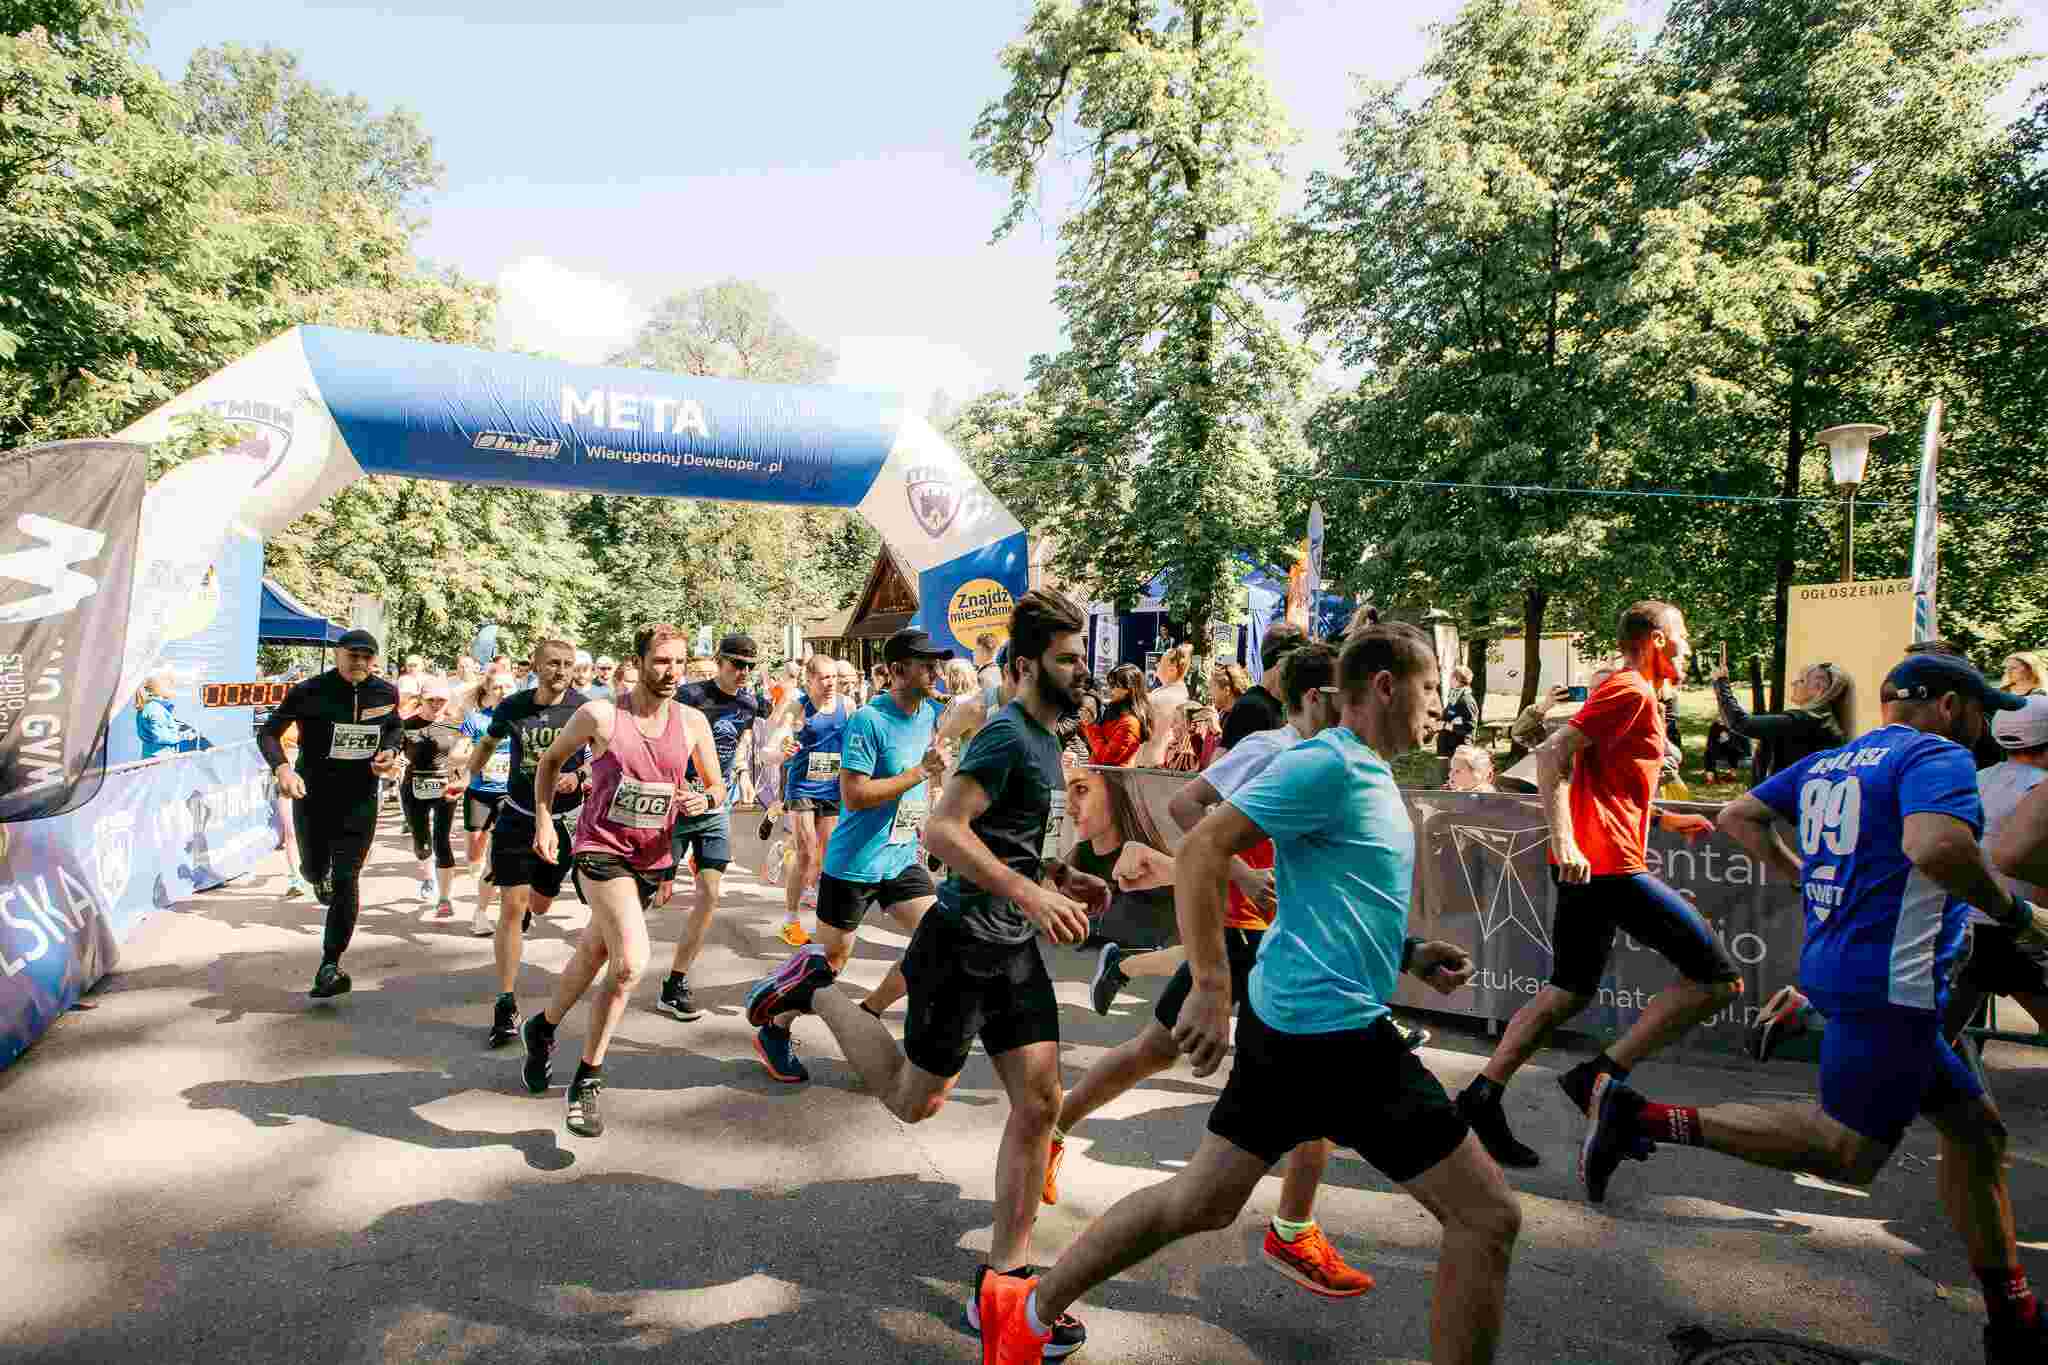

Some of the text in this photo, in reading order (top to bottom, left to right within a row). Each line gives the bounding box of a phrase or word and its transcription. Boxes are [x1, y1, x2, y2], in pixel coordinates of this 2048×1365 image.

[559, 383, 710, 438] META
[585, 446, 681, 467] Wiarygodny
[1800, 585, 1896, 601] OGŁOSZENIA
[2, 653, 26, 712] STUDIO
[1799, 775, 1862, 856] 89
